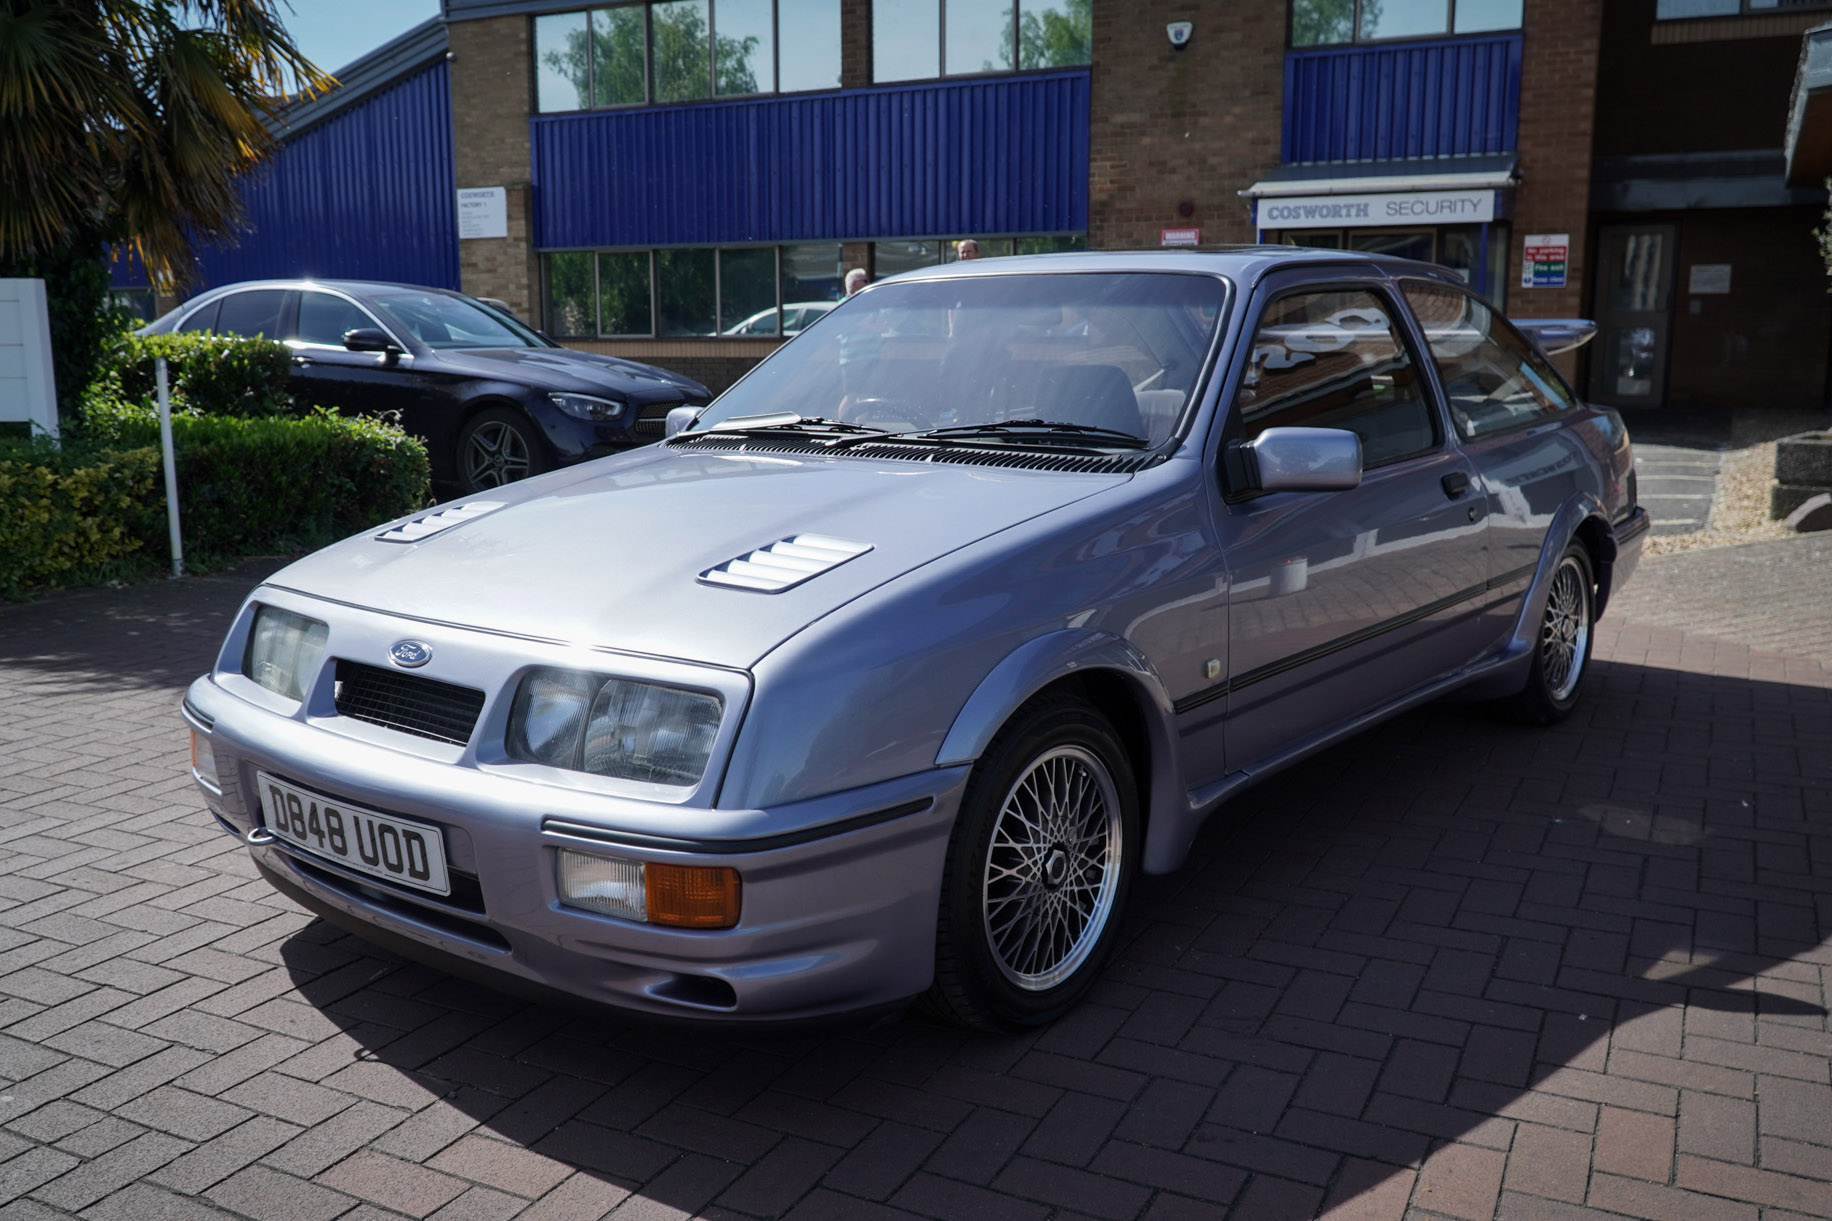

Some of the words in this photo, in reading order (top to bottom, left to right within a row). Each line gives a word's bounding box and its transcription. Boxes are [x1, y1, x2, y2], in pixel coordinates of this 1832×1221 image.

[1267, 203, 1369, 220] COSWORTH
[1385, 198, 1482, 217] SECURITY
[395, 644, 421, 660] Ford
[269, 784, 349, 857] D848
[353, 815, 431, 882] UOD
